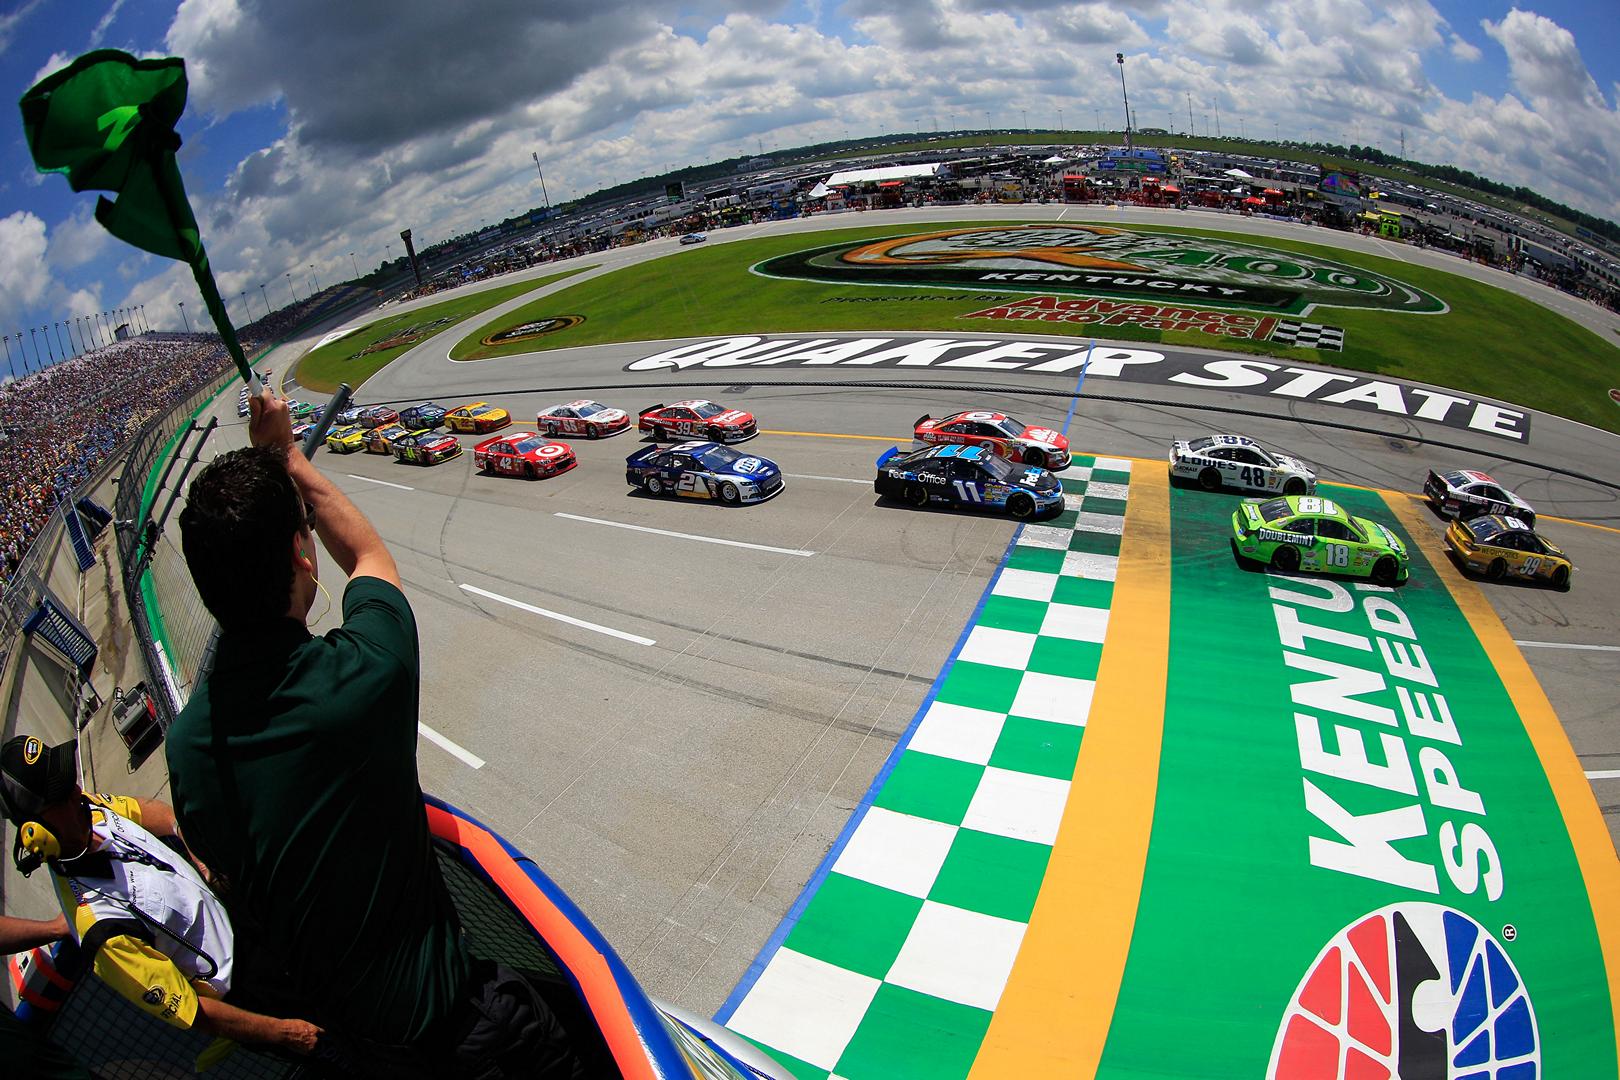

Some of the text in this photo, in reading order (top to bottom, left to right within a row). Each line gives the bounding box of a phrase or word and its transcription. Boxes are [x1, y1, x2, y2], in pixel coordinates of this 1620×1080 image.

[978, 272, 1247, 295] KENTUCKY
[1002, 296, 1258, 326] Advance
[956, 306, 1253, 340] Auto Parts
[628, 335, 1524, 439] QUAKER STATE
[676, 421, 691, 435] 39
[500, 457, 512, 470] 42
[1181, 455, 1237, 470] LOWE'S
[678, 472, 695, 491] 2
[917, 471, 947, 485] Office
[1241, 466, 1265, 487] 48
[953, 480, 981, 503] 11
[1258, 528, 1316, 548] DOUBLEMINT
[1325, 543, 1349, 567] 18
[1520, 557, 1540, 575] 99
[1355, 582, 1504, 902] SPEED
